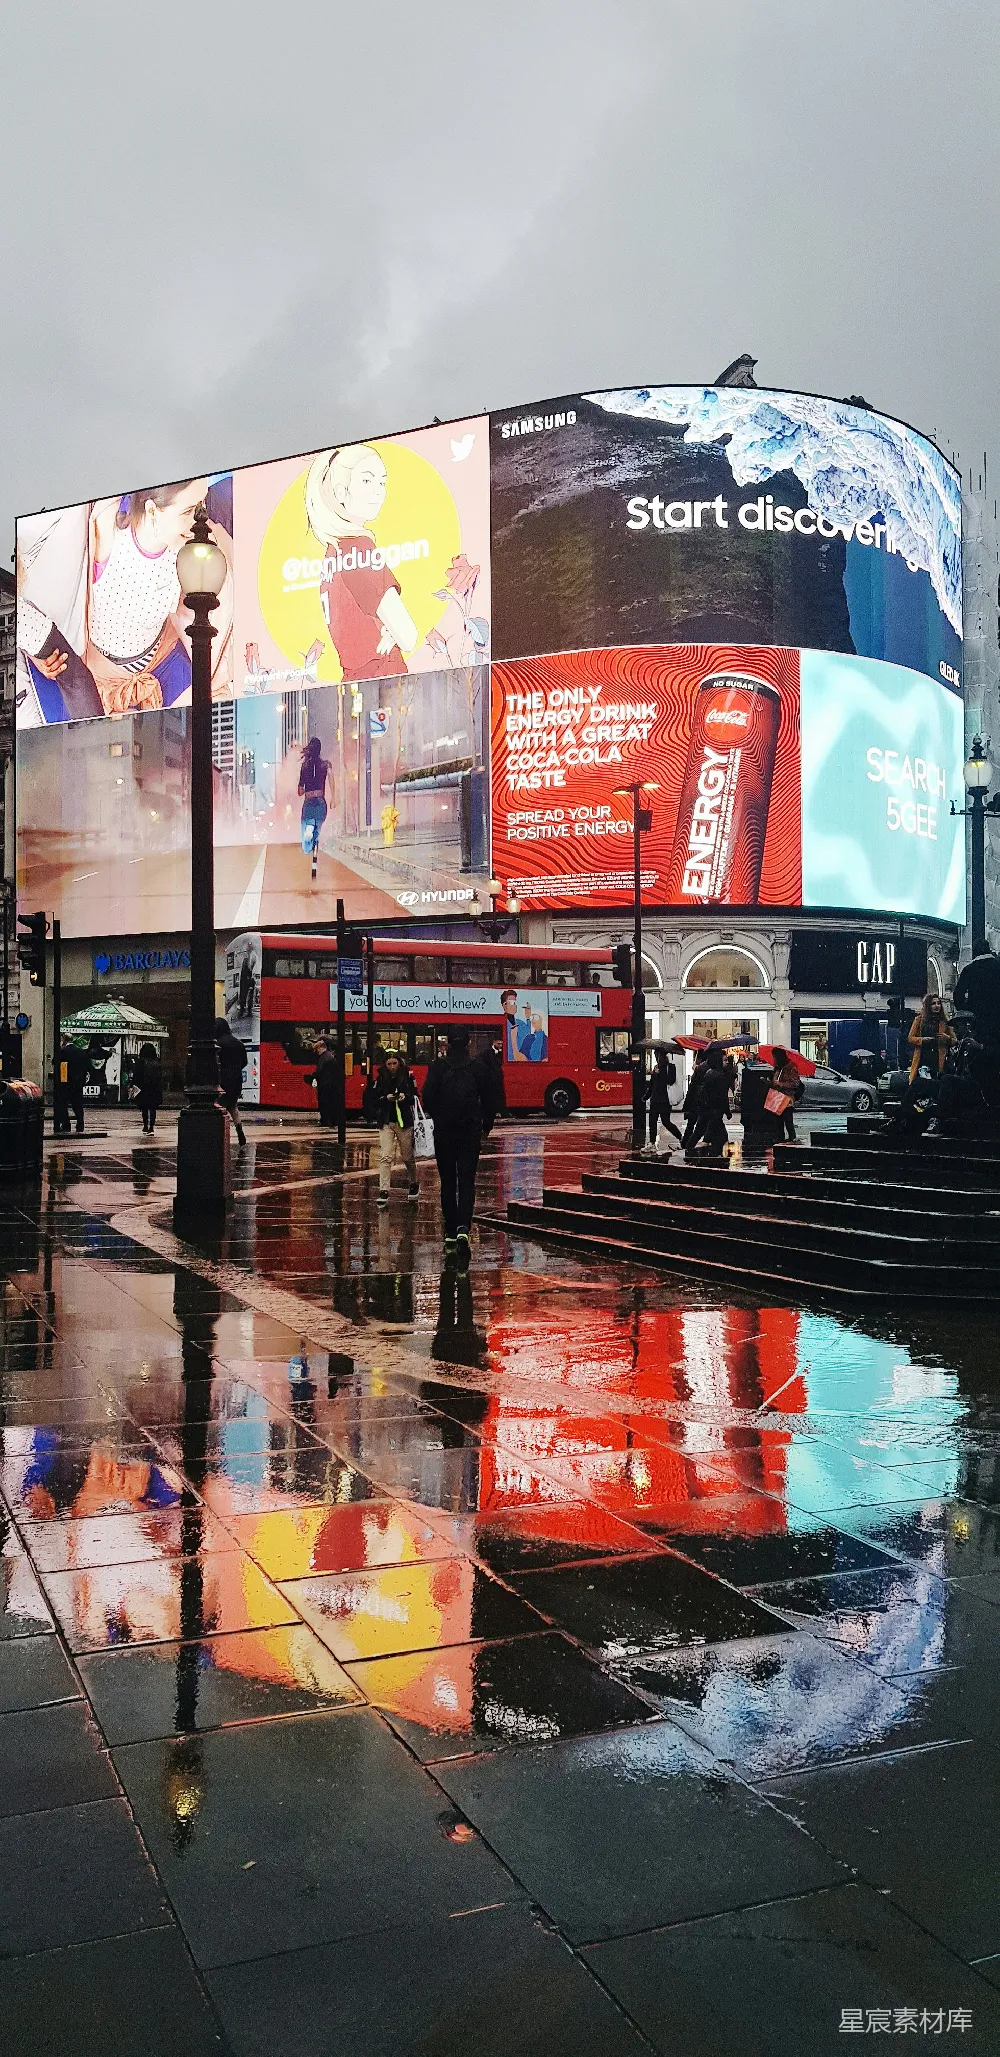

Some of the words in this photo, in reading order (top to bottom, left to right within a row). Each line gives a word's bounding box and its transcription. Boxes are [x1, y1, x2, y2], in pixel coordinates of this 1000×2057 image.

[501, 410, 577, 439] SAMSUNG
[626, 494, 729, 530] Start
[282, 538, 430, 582] @toniduggan
[505, 691, 544, 712] THE
[548, 685, 602, 707] ONLY
[726, 681, 754, 690] SUGAR
[506, 707, 584, 732] ENERGY
[590, 702, 658, 723] DRINK
[505, 730, 557, 750] WITH
[562, 729, 576, 745] A
[581, 723, 652, 743] GREAT
[506, 769, 566, 791] TASTE
[866, 746, 946, 801] SEARCH
[506, 808, 565, 826] SPREAD
[568, 805, 611, 820] YOUR
[682, 745, 729, 896] ENERGY
[886, 796, 938, 841] 5GEE
[507, 824, 570, 841] POSITIVE
[575, 820, 635, 836] ENERGY
[421, 889, 474, 903] HYUNDA
[113, 949, 191, 970] BARCLAYS
[857, 940, 895, 984] GAP
[374, 993, 391, 1007] blu
[395, 995, 421, 1008] too?
[424, 994, 448, 1009] who
[452, 995, 487, 1009] knew?
[596, 1080, 610, 1092] Go
